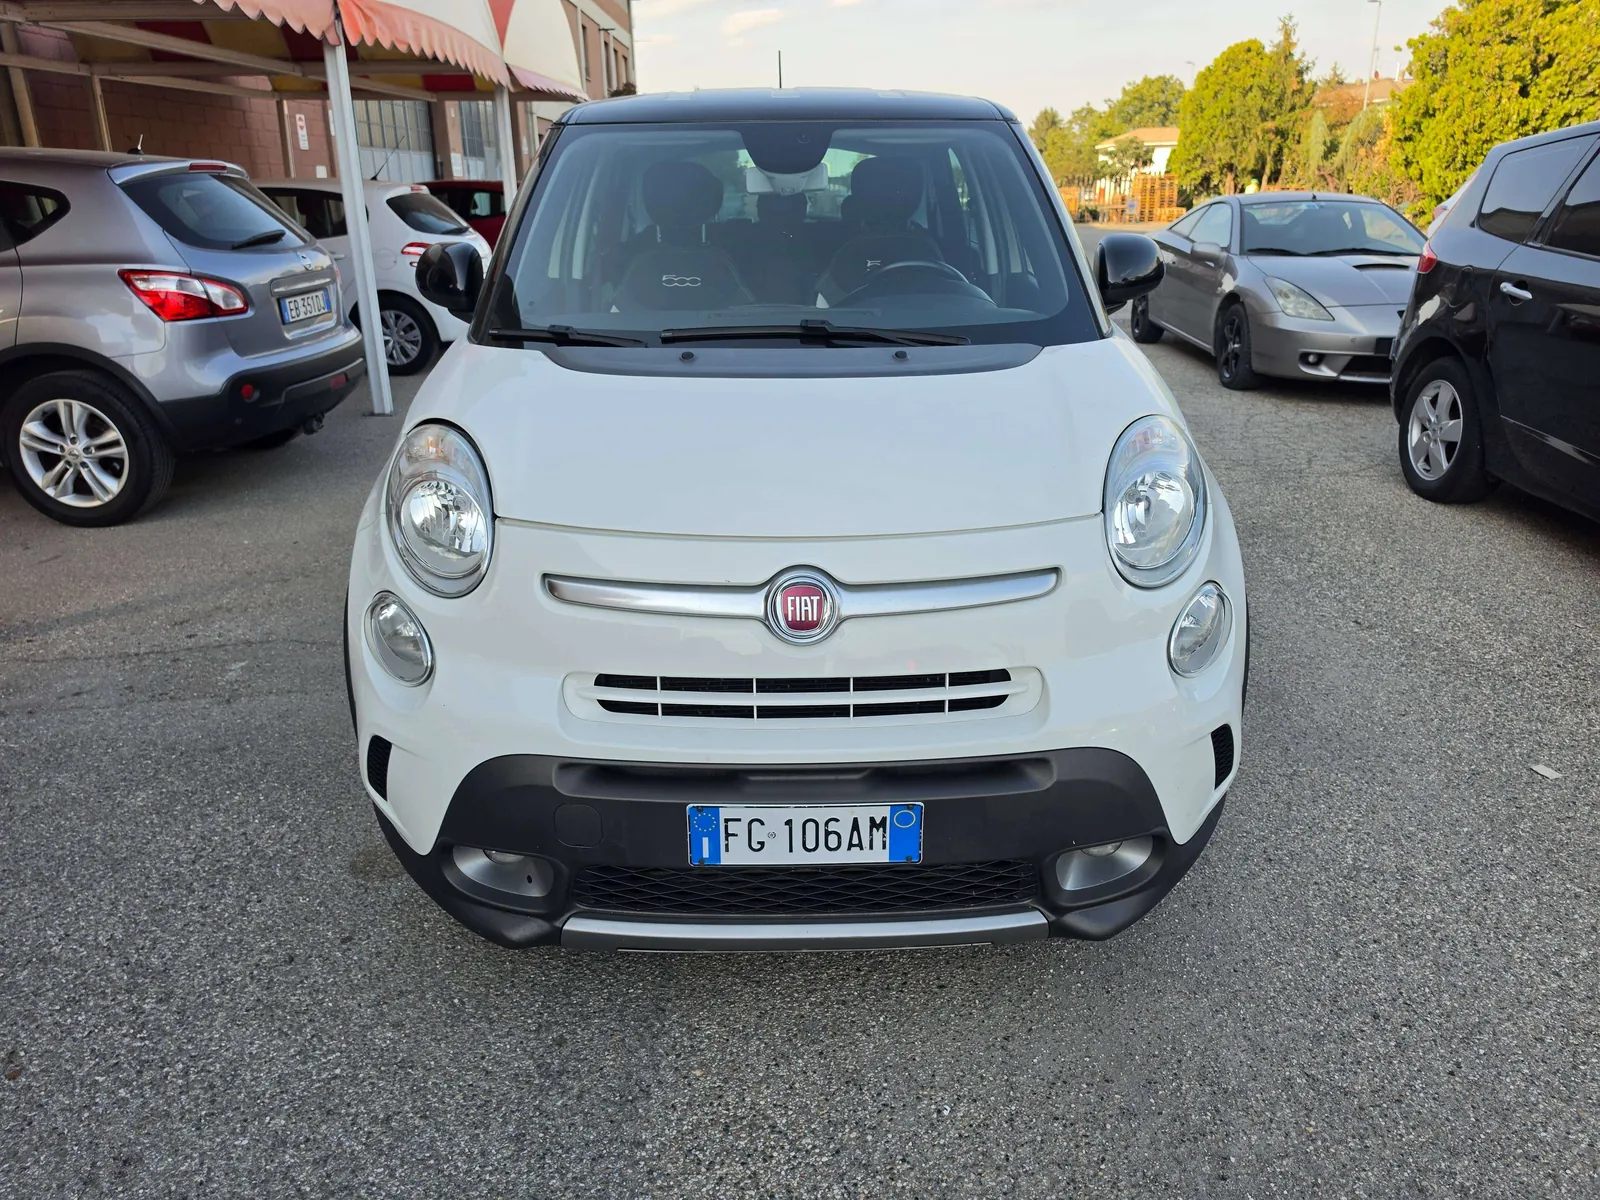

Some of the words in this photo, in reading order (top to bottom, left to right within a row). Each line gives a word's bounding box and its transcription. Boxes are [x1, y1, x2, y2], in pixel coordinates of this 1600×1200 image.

[662, 275, 701, 287] 500
[288, 299, 301, 319] EB
[787, 596, 820, 621] FIAT
[724, 817, 766, 853] FG
[784, 816, 888, 853] 106AM
